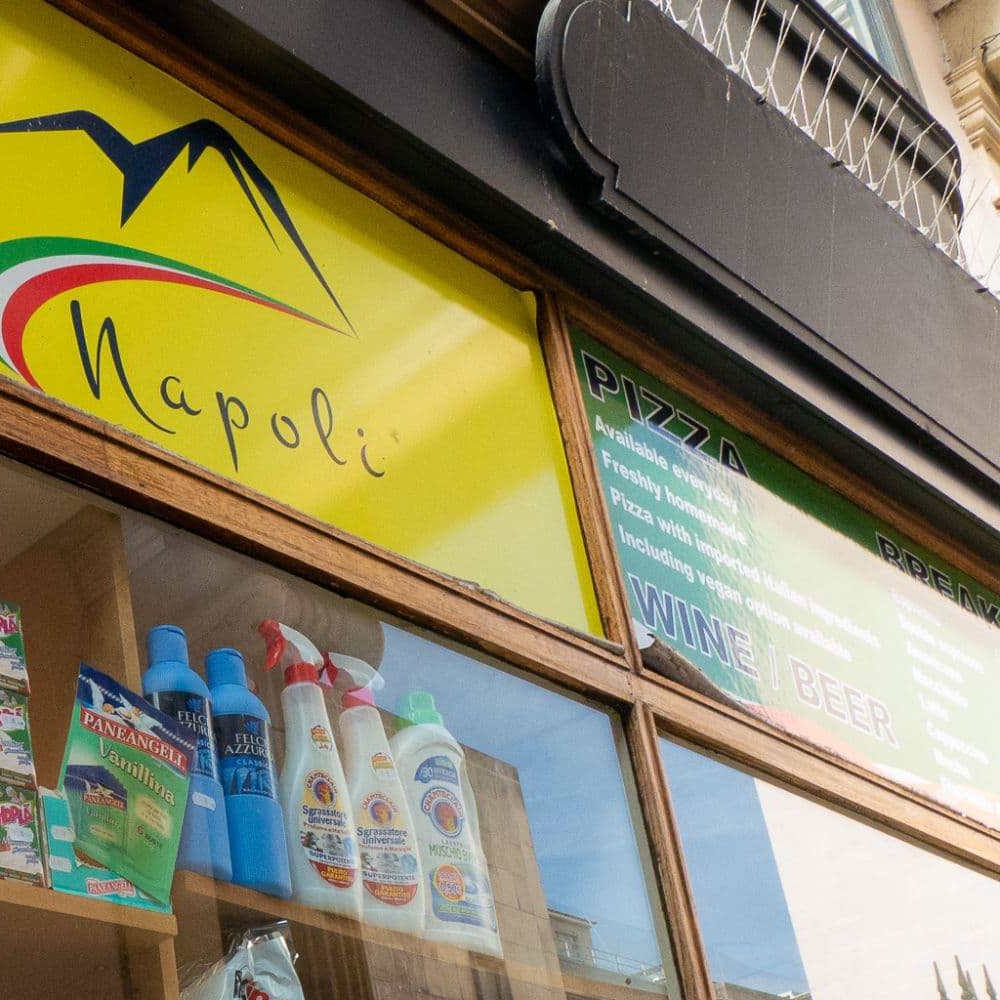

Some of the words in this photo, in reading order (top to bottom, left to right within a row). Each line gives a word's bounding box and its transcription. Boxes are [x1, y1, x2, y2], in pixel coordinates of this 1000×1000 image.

[70, 300, 386, 477] Napoli
[580, 349, 752, 480] PIZZA
[594, 414, 668, 471] Available
[672, 461, 740, 515] everyday
[601, 449, 662, 502] Freshly
[664, 484, 748, 546] homemade
[609, 485, 654, 527] Pizza
[657, 514, 693, 547] with
[695, 531, 761, 586] imported
[618, 523, 695, 583] Including
[697, 568, 743, 606] vegan
[629, 573, 760, 681] WINE
[789, 656, 898, 751] BEER
[83, 712, 184, 768] PANEANGELI
[98, 736, 176, 808] Vanillina
[356, 826, 408, 838] Sgrassatore
